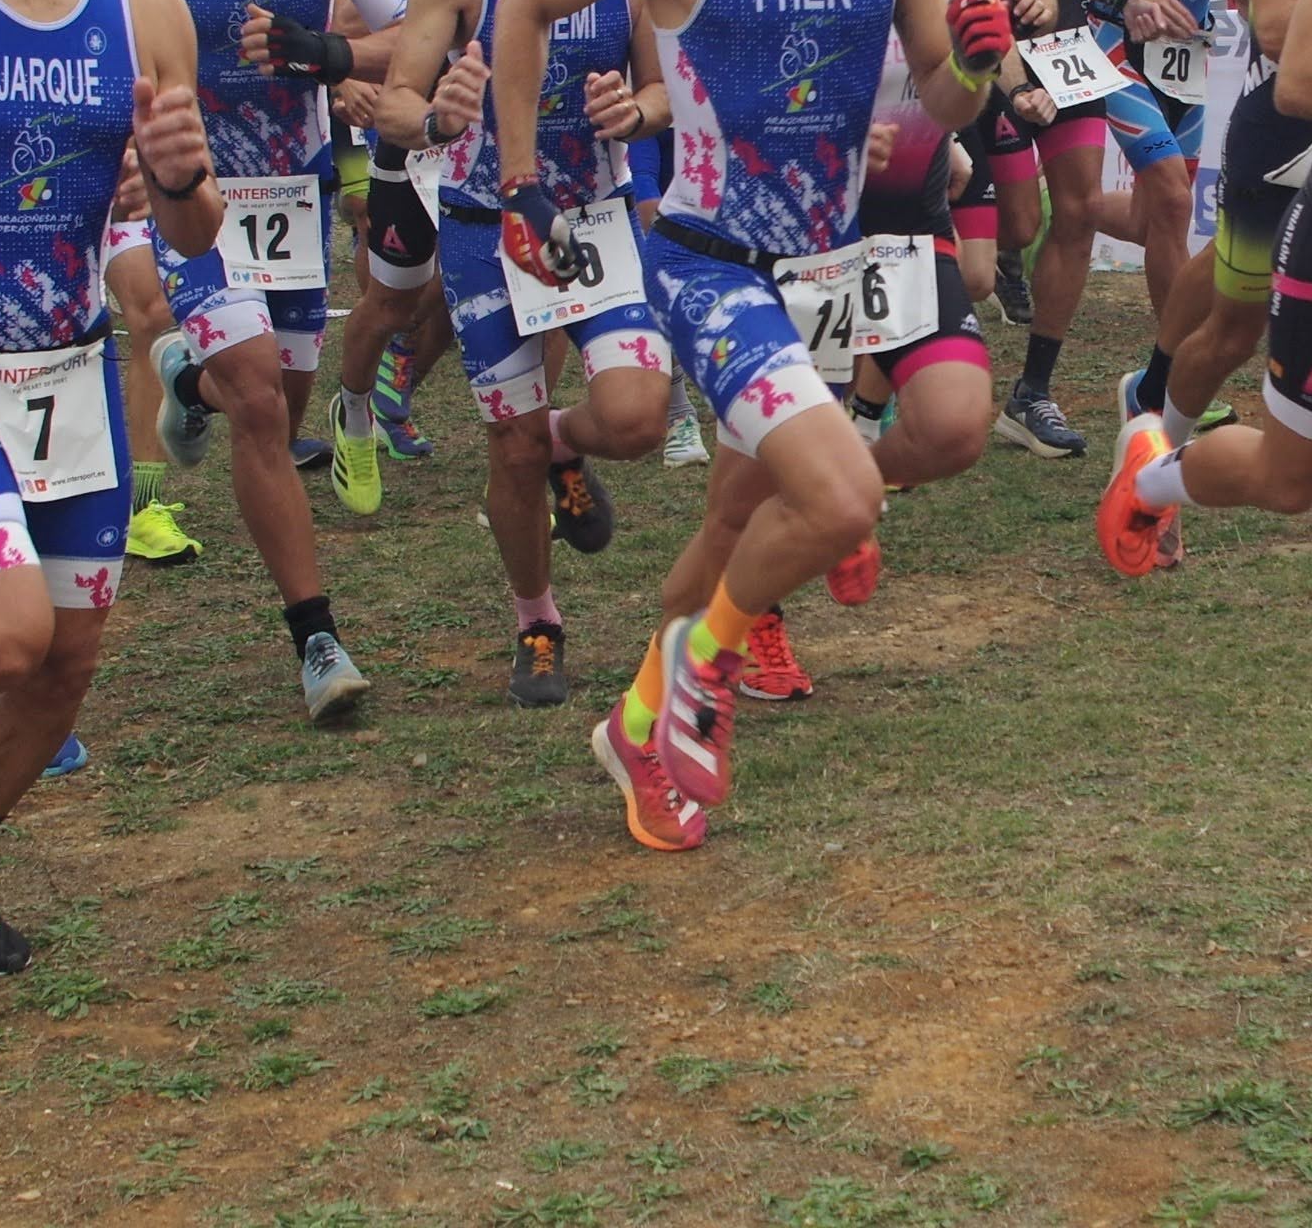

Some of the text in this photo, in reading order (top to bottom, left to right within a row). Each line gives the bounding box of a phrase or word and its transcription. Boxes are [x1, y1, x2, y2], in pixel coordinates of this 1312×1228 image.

[1051, 55, 1098, 86] 24
[1161, 47, 1191, 83] 20
[228, 185, 310, 200] INTERSPORT
[239, 212, 292, 261] 12
[862, 270, 890, 321] 6
[809, 292, 854, 352] 14
[26, 394, 55, 461] 7
[51, 470, 106, 486] www.intersport.es
